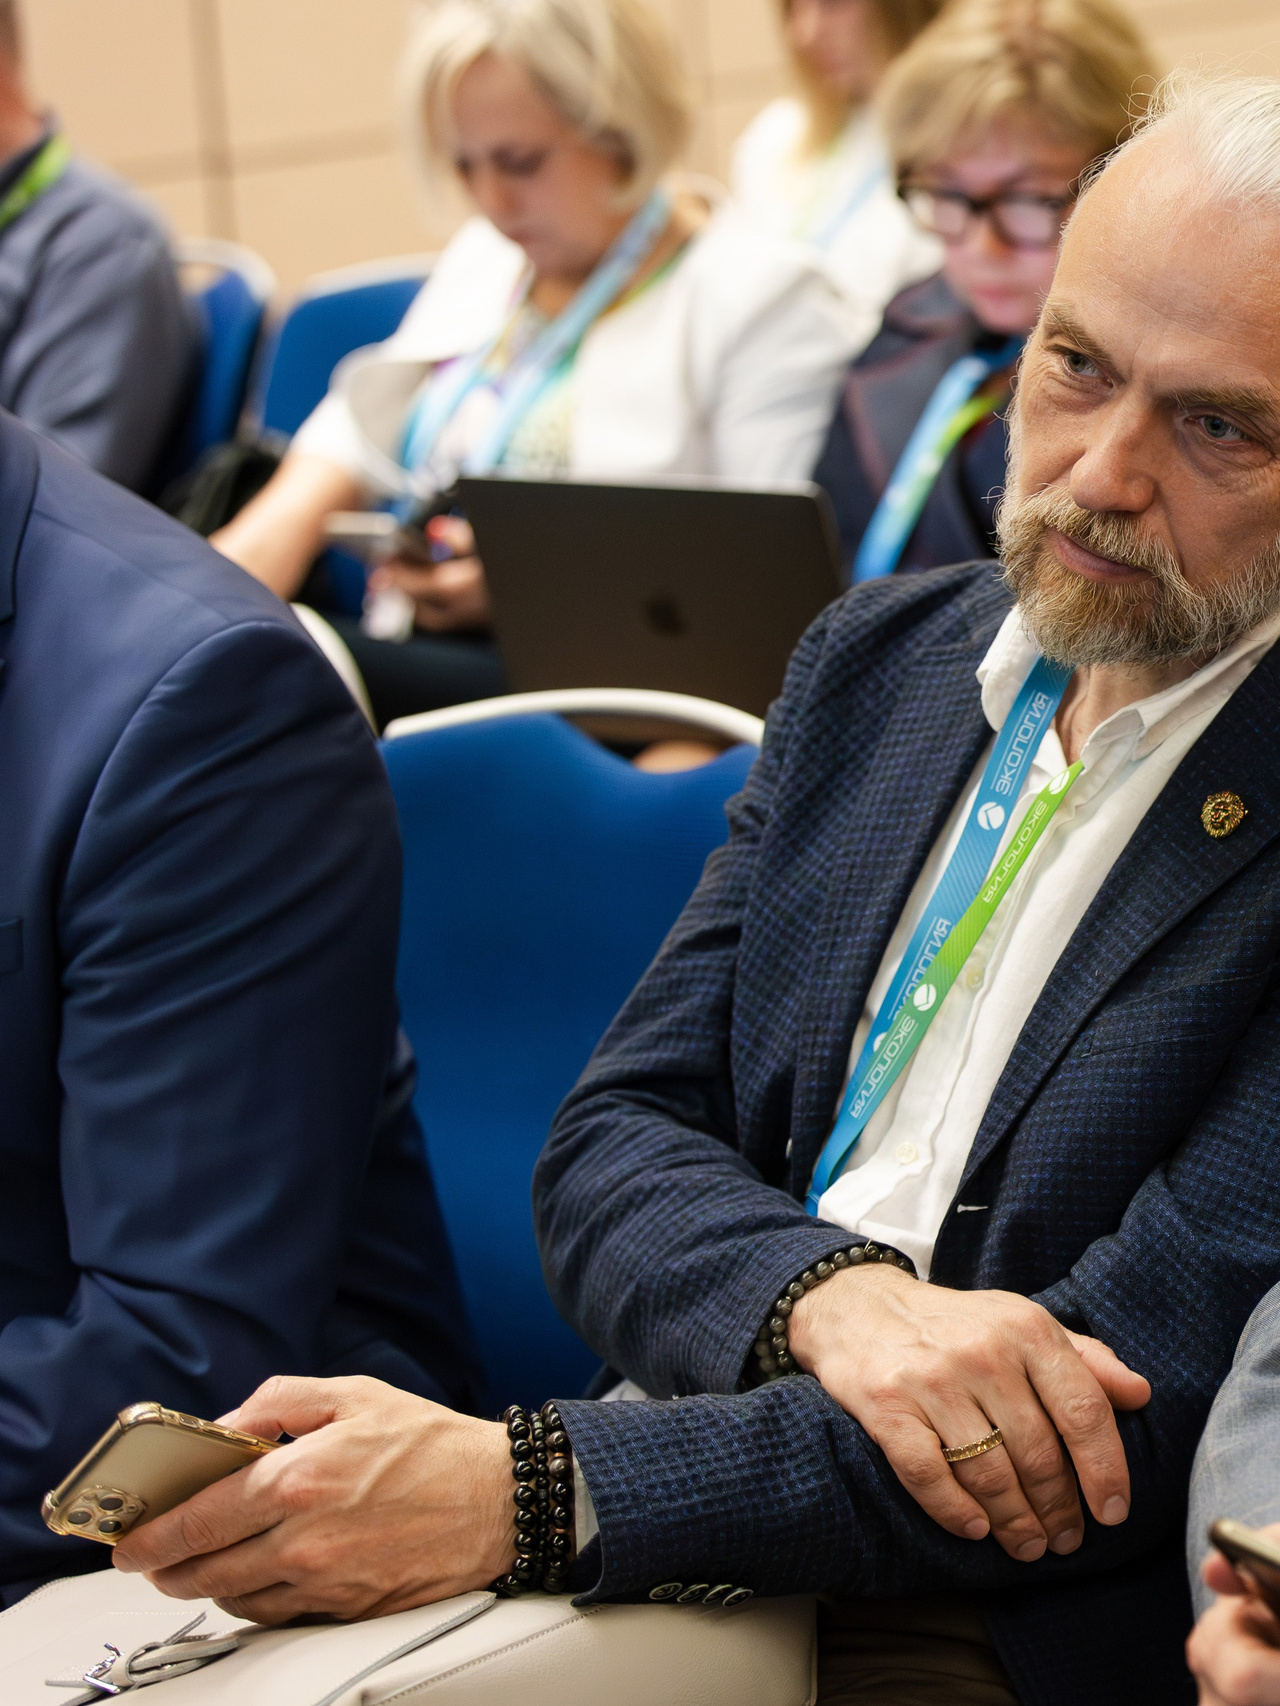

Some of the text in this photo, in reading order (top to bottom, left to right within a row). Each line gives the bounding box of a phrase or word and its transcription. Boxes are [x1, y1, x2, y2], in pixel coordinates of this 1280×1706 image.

[995, 691, 1049, 795] ЭКОЛОГИЯ
[983, 801, 1047, 903] ЭКОЛОГИЯ
[850, 1015, 915, 1119] ЭКОЛОГИЯ
